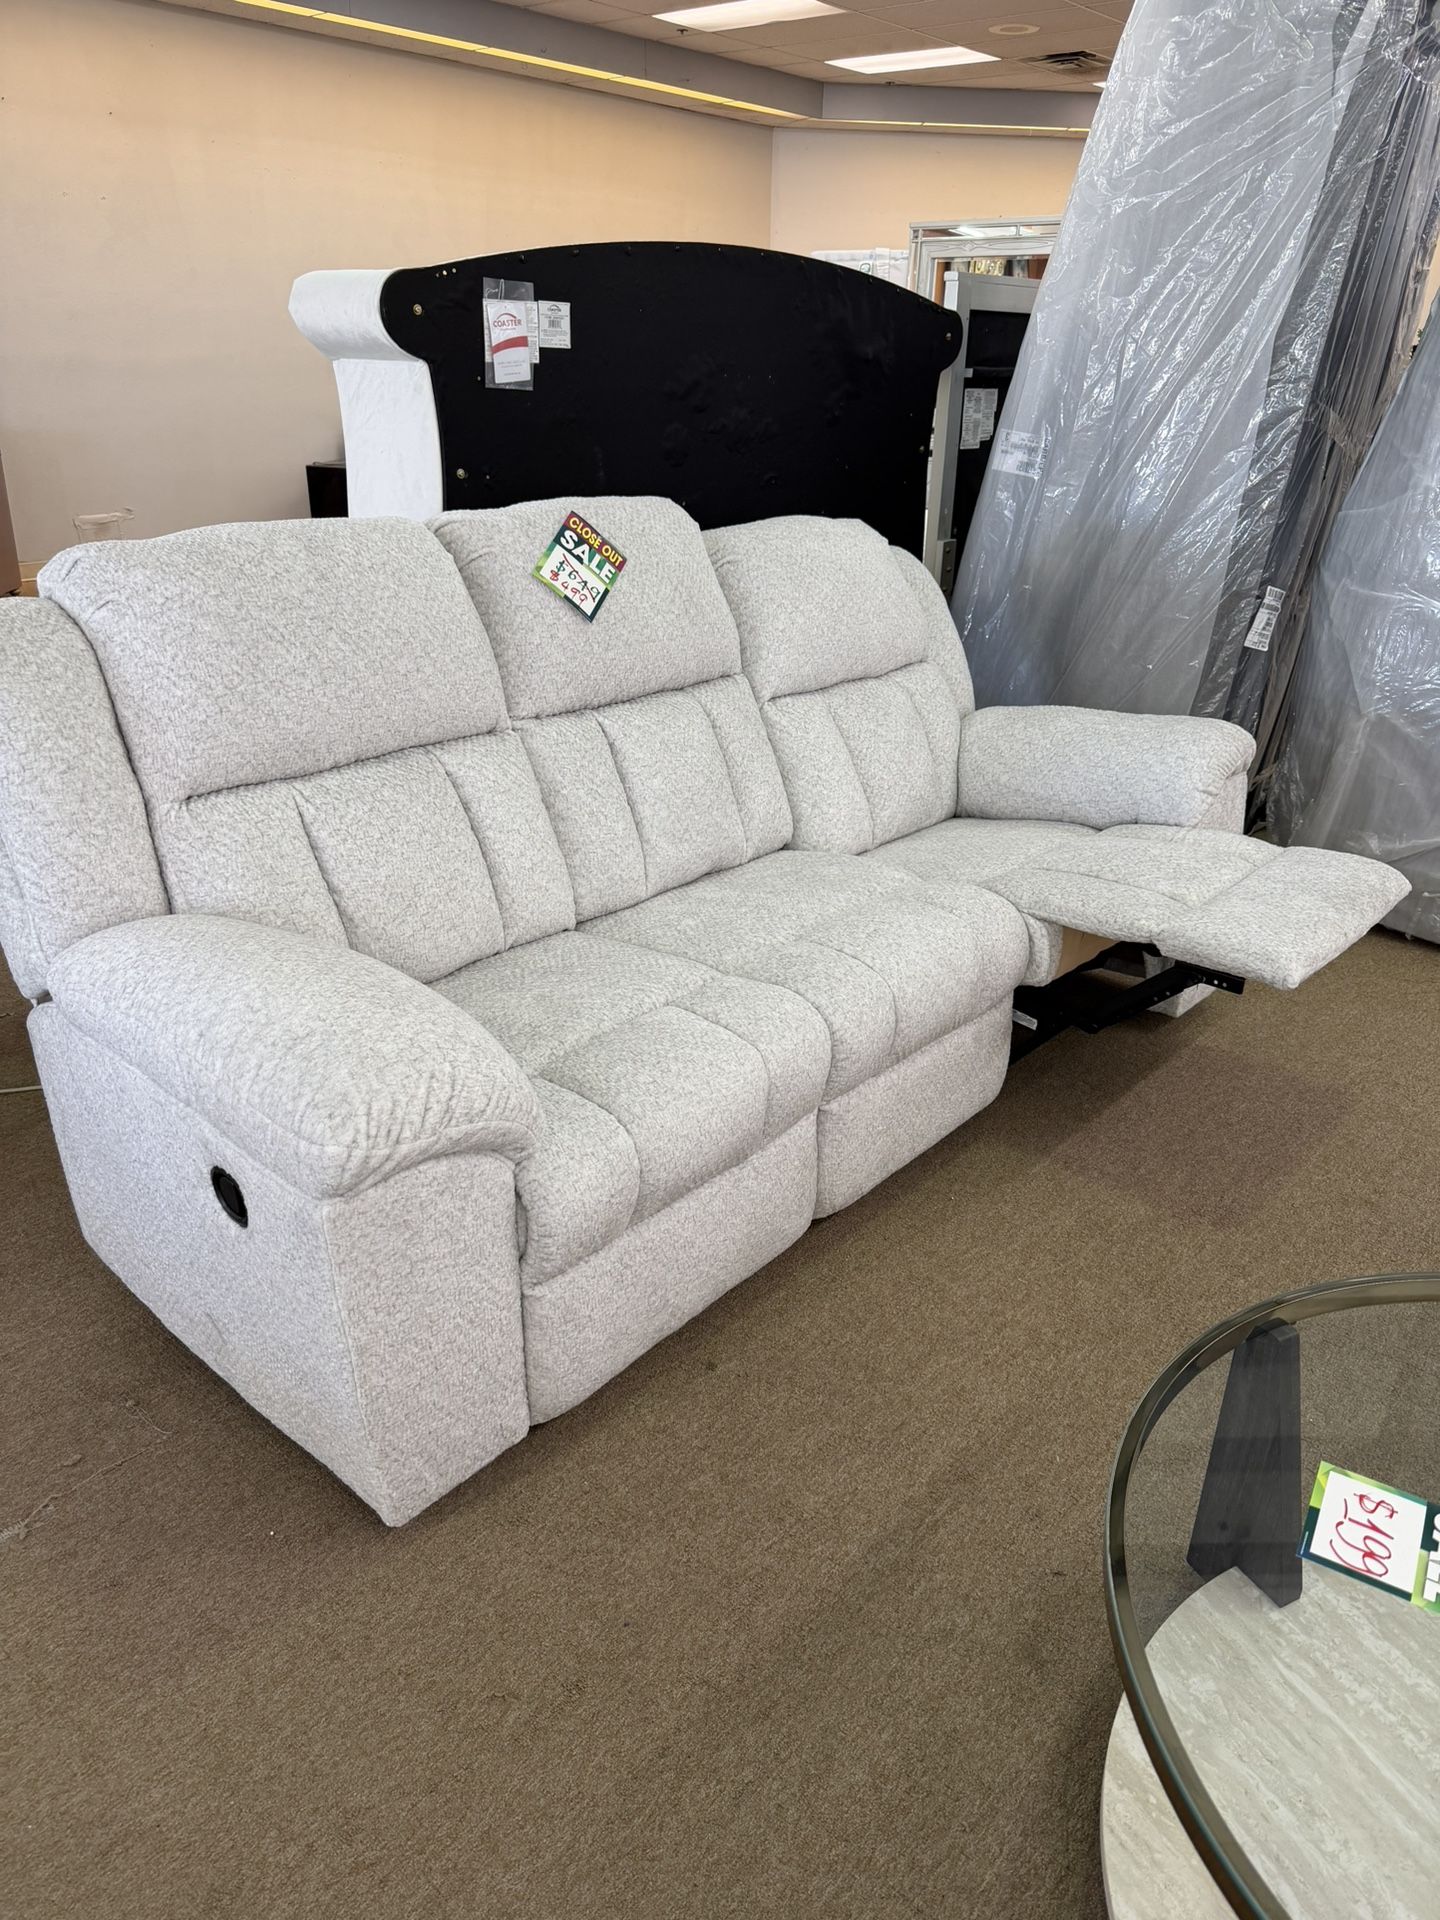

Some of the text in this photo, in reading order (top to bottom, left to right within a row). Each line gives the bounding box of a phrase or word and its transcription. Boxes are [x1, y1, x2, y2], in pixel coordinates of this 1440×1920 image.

[493, 319, 522, 328] COASTER
[560, 529, 616, 584] SALE
[569, 517, 623, 567] CLOSE OUT
[1329, 1493, 1399, 1578] $199
